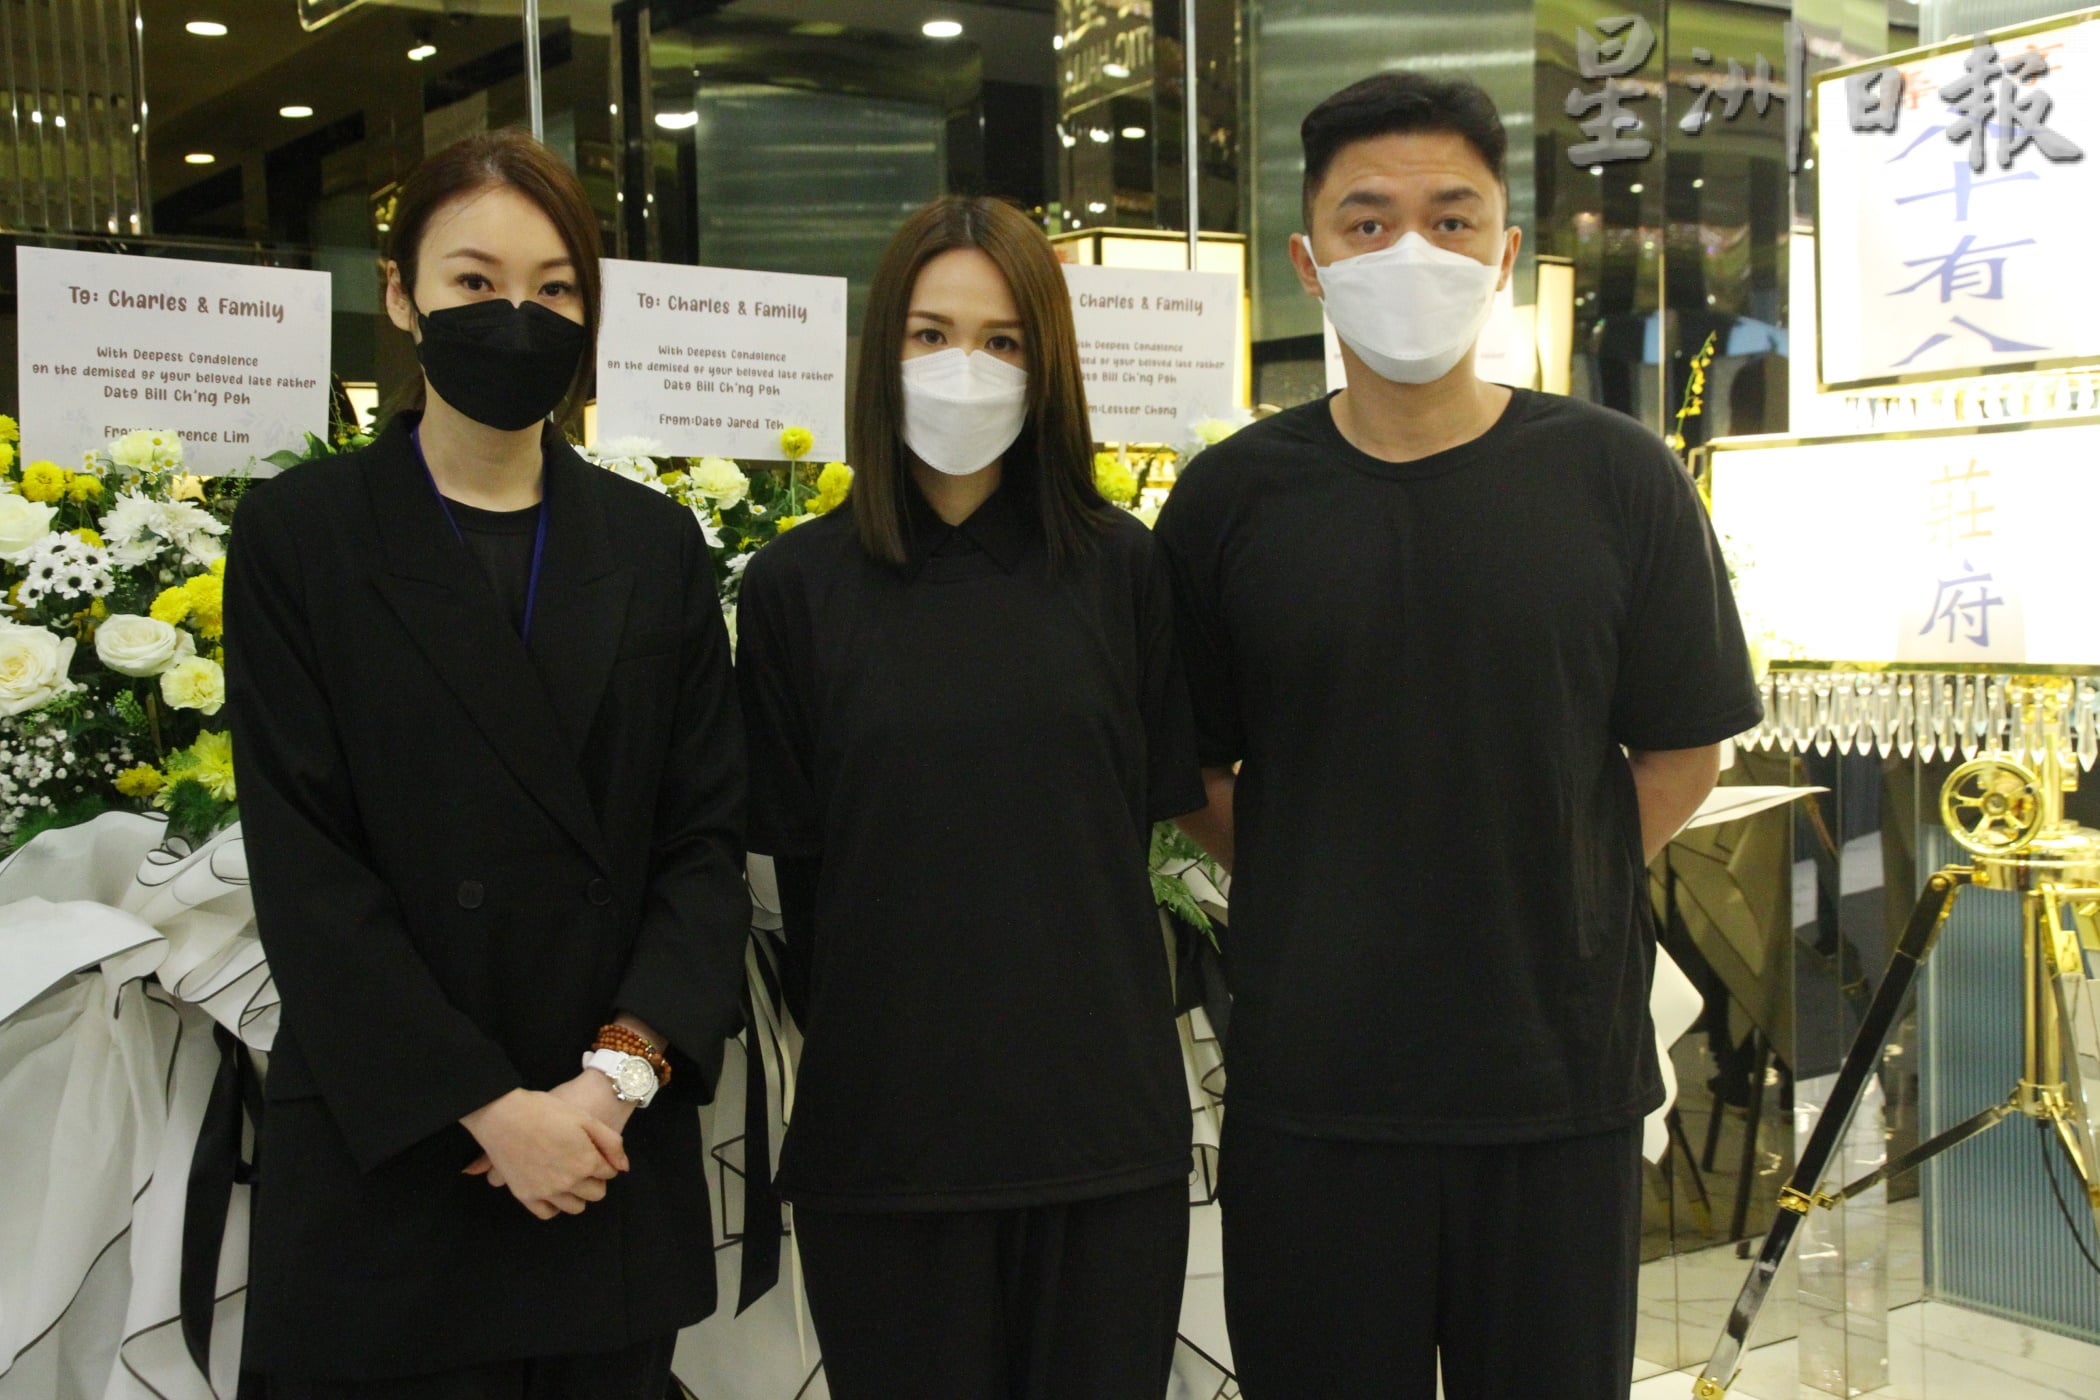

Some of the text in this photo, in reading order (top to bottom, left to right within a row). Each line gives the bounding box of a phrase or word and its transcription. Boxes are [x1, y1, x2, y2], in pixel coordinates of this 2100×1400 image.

[68, 286, 284, 323] To: Charles & Family
[637, 293, 807, 324] To: Charles & Family
[1080, 293, 1203, 316] Charles & Family
[659, 345, 786, 362] With Deepest Condolence
[1095, 341, 1130, 350] Deepest
[1134, 342, 1183, 352] Condolence
[97, 347, 258, 367] With Deepest Condolence
[1113, 358, 1135, 368] your
[1138, 358, 1172, 367] beloved
[33, 364, 316, 388] on the demised of your beloved late father
[608, 360, 834, 381] on the demised of your beloved late father
[1102, 372, 1118, 382] Bill
[1158, 374, 1176, 384] Poh
[104, 386, 250, 407] Dato Bill Ch'ng Poh
[664, 379, 691, 391] Dato
[697, 381, 714, 392] Bill
[759, 384, 780, 395] Poh
[727, 417, 759, 429] Jared
[765, 419, 783, 430] Teh
[224, 431, 249, 443] Lim
[1919, 458, 2005, 648] 莊府
